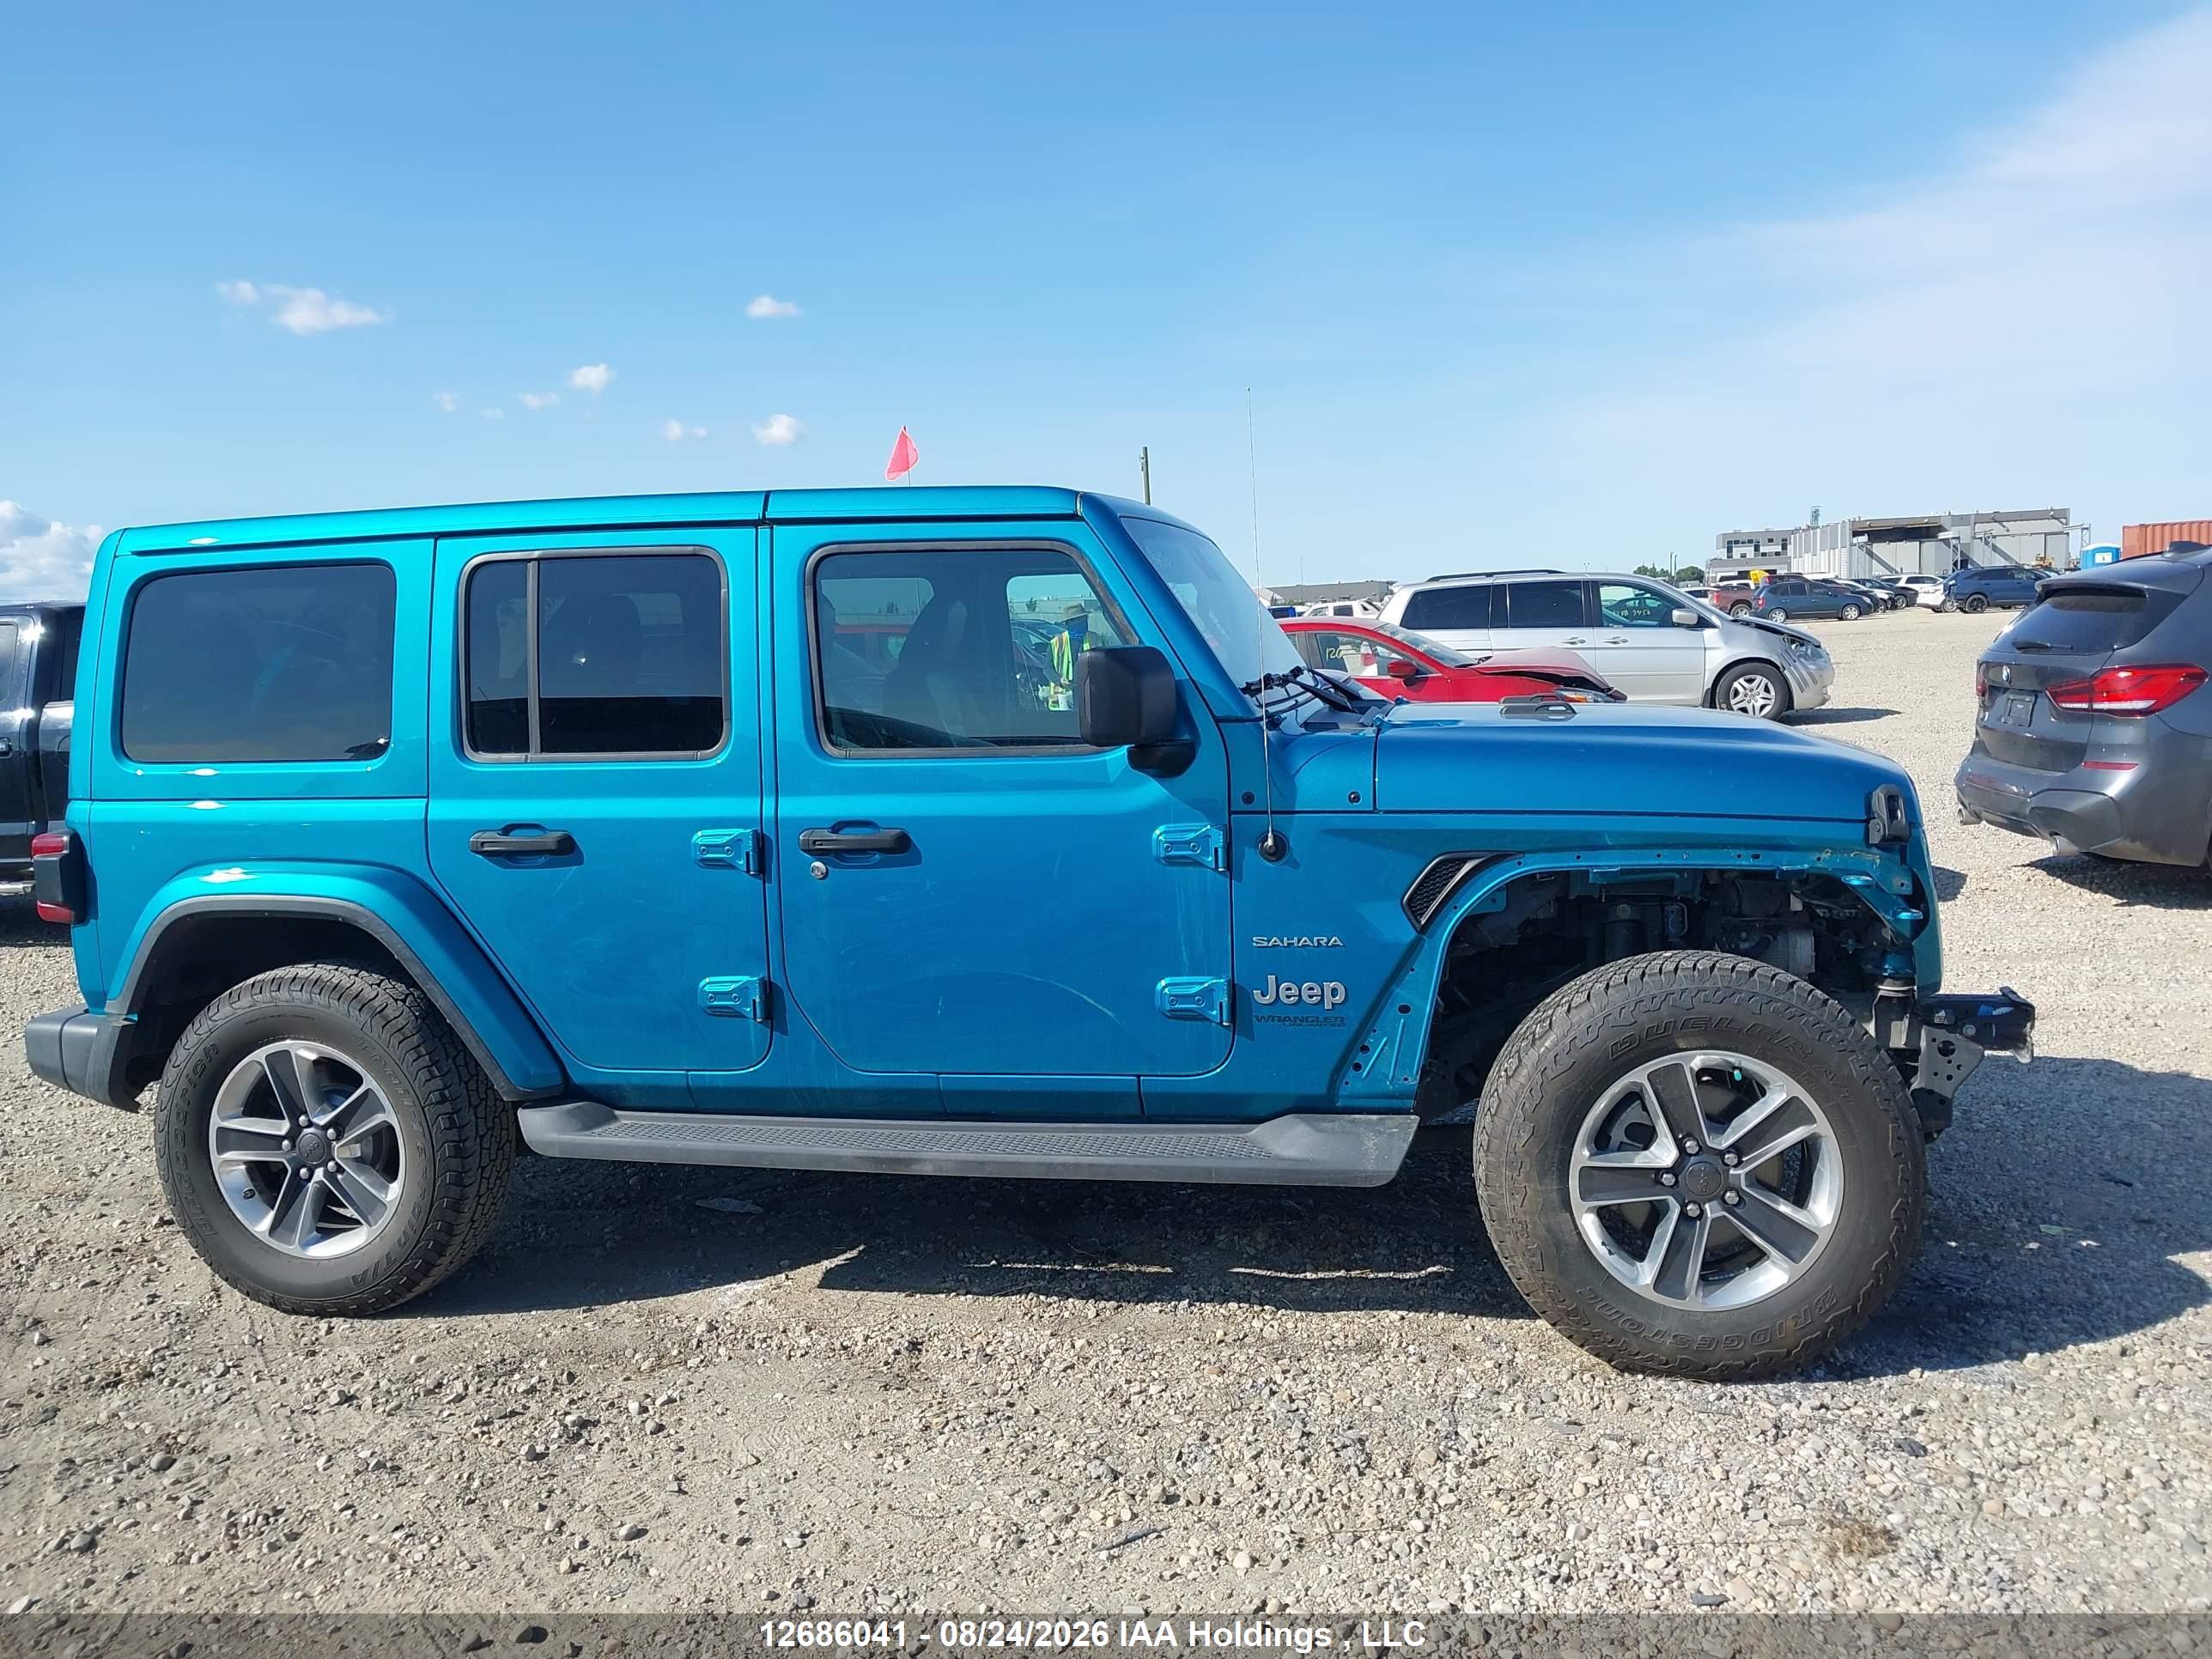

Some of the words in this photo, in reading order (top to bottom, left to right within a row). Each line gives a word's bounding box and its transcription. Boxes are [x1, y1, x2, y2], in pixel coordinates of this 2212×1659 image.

[1252, 936, 1344, 947] SAHARA
[1253, 975, 1346, 1010] Jeep
[1254, 1015, 1346, 1024] WRANGLER
[1608, 1016, 1814, 1060] DUELER
